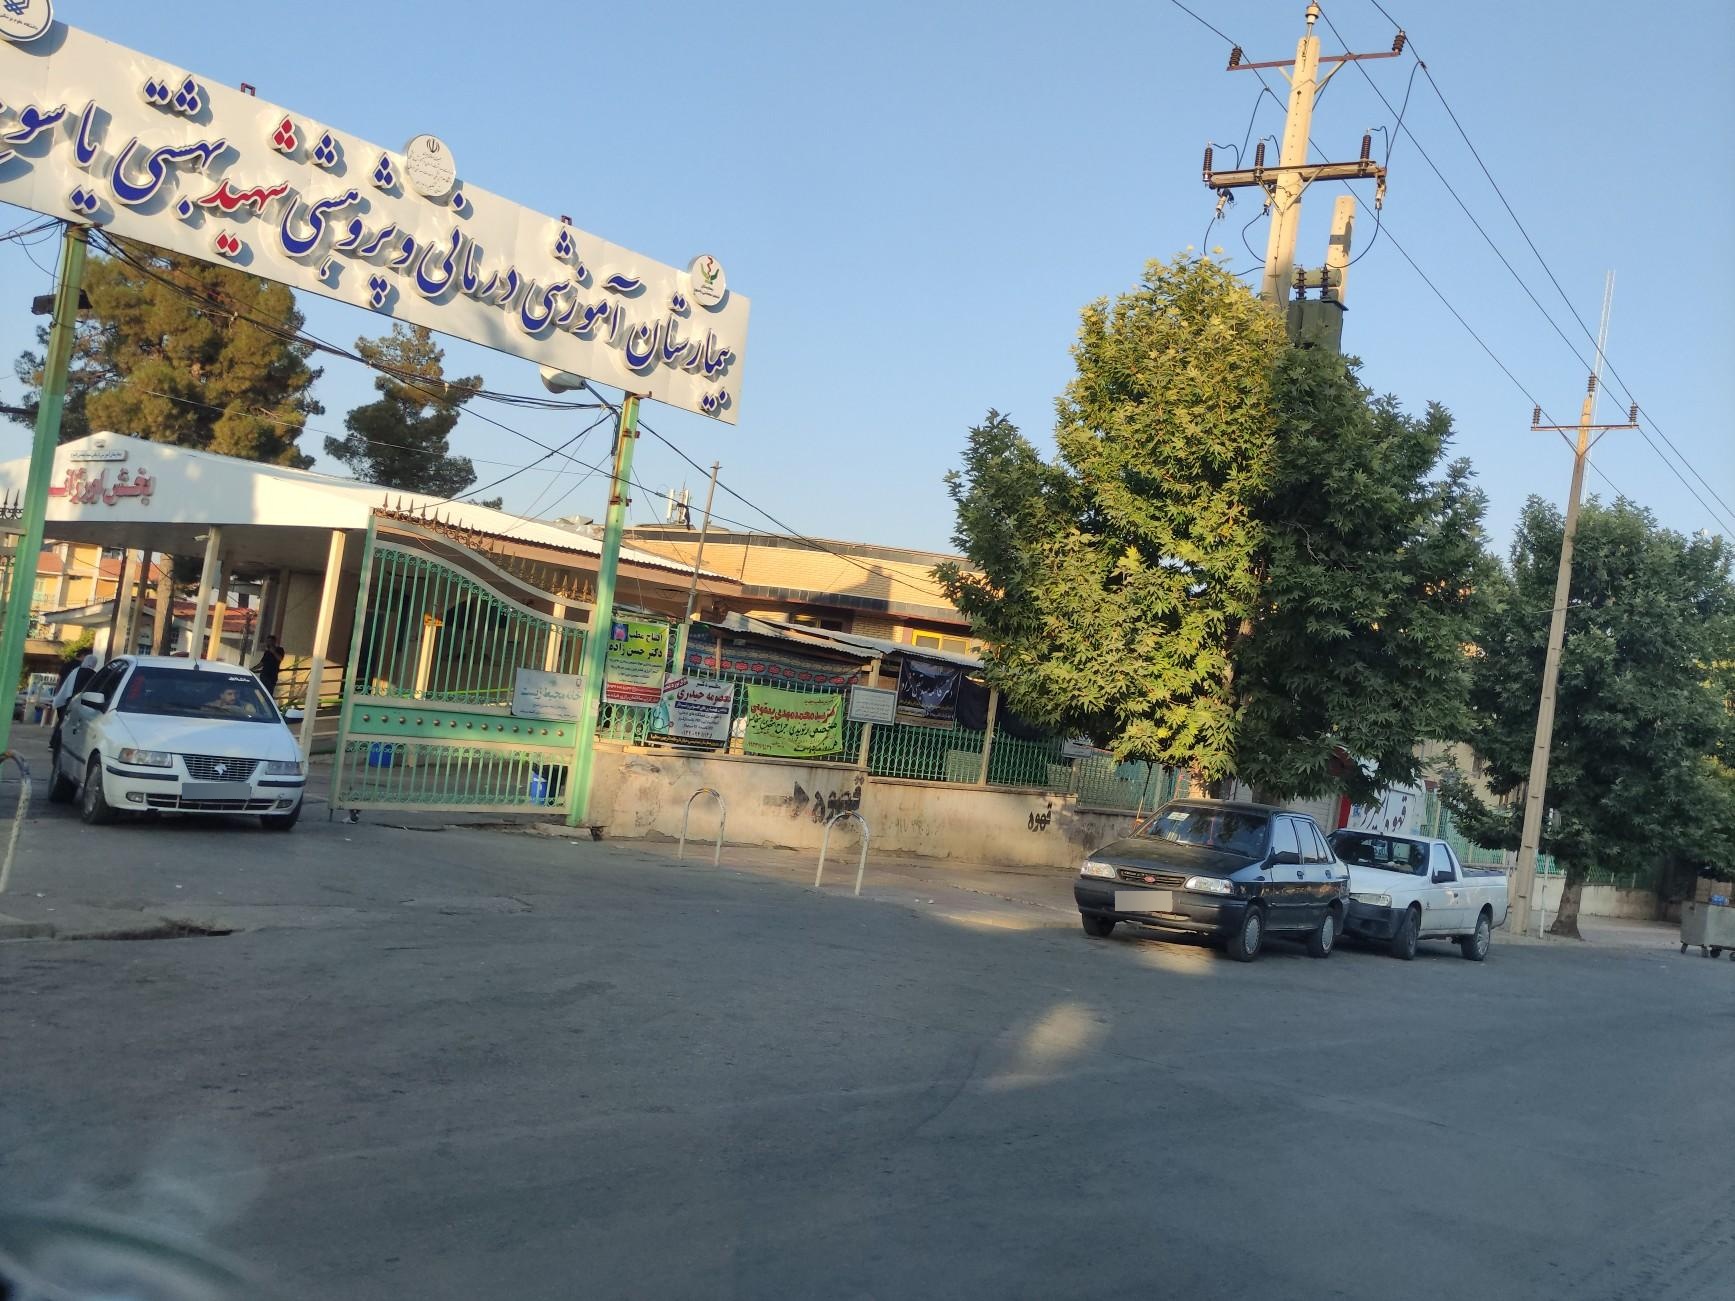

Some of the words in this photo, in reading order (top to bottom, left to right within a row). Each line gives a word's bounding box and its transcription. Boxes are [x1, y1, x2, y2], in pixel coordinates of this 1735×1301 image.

[110, 74, 229, 220] بهشتی
[198, 114, 299, 256] شهید
[279, 130, 398, 308] پژوهشی
[391, 233, 418, 268] و
[414, 189, 521, 305] درمانی
[520, 225, 641, 345] آموزشی
[624, 289, 733, 413] بیمارستان
[48, 466, 106, 505] اورژان
[647, 648, 662, 660] دکتر
[1027, 801, 1053, 833] قهوه
